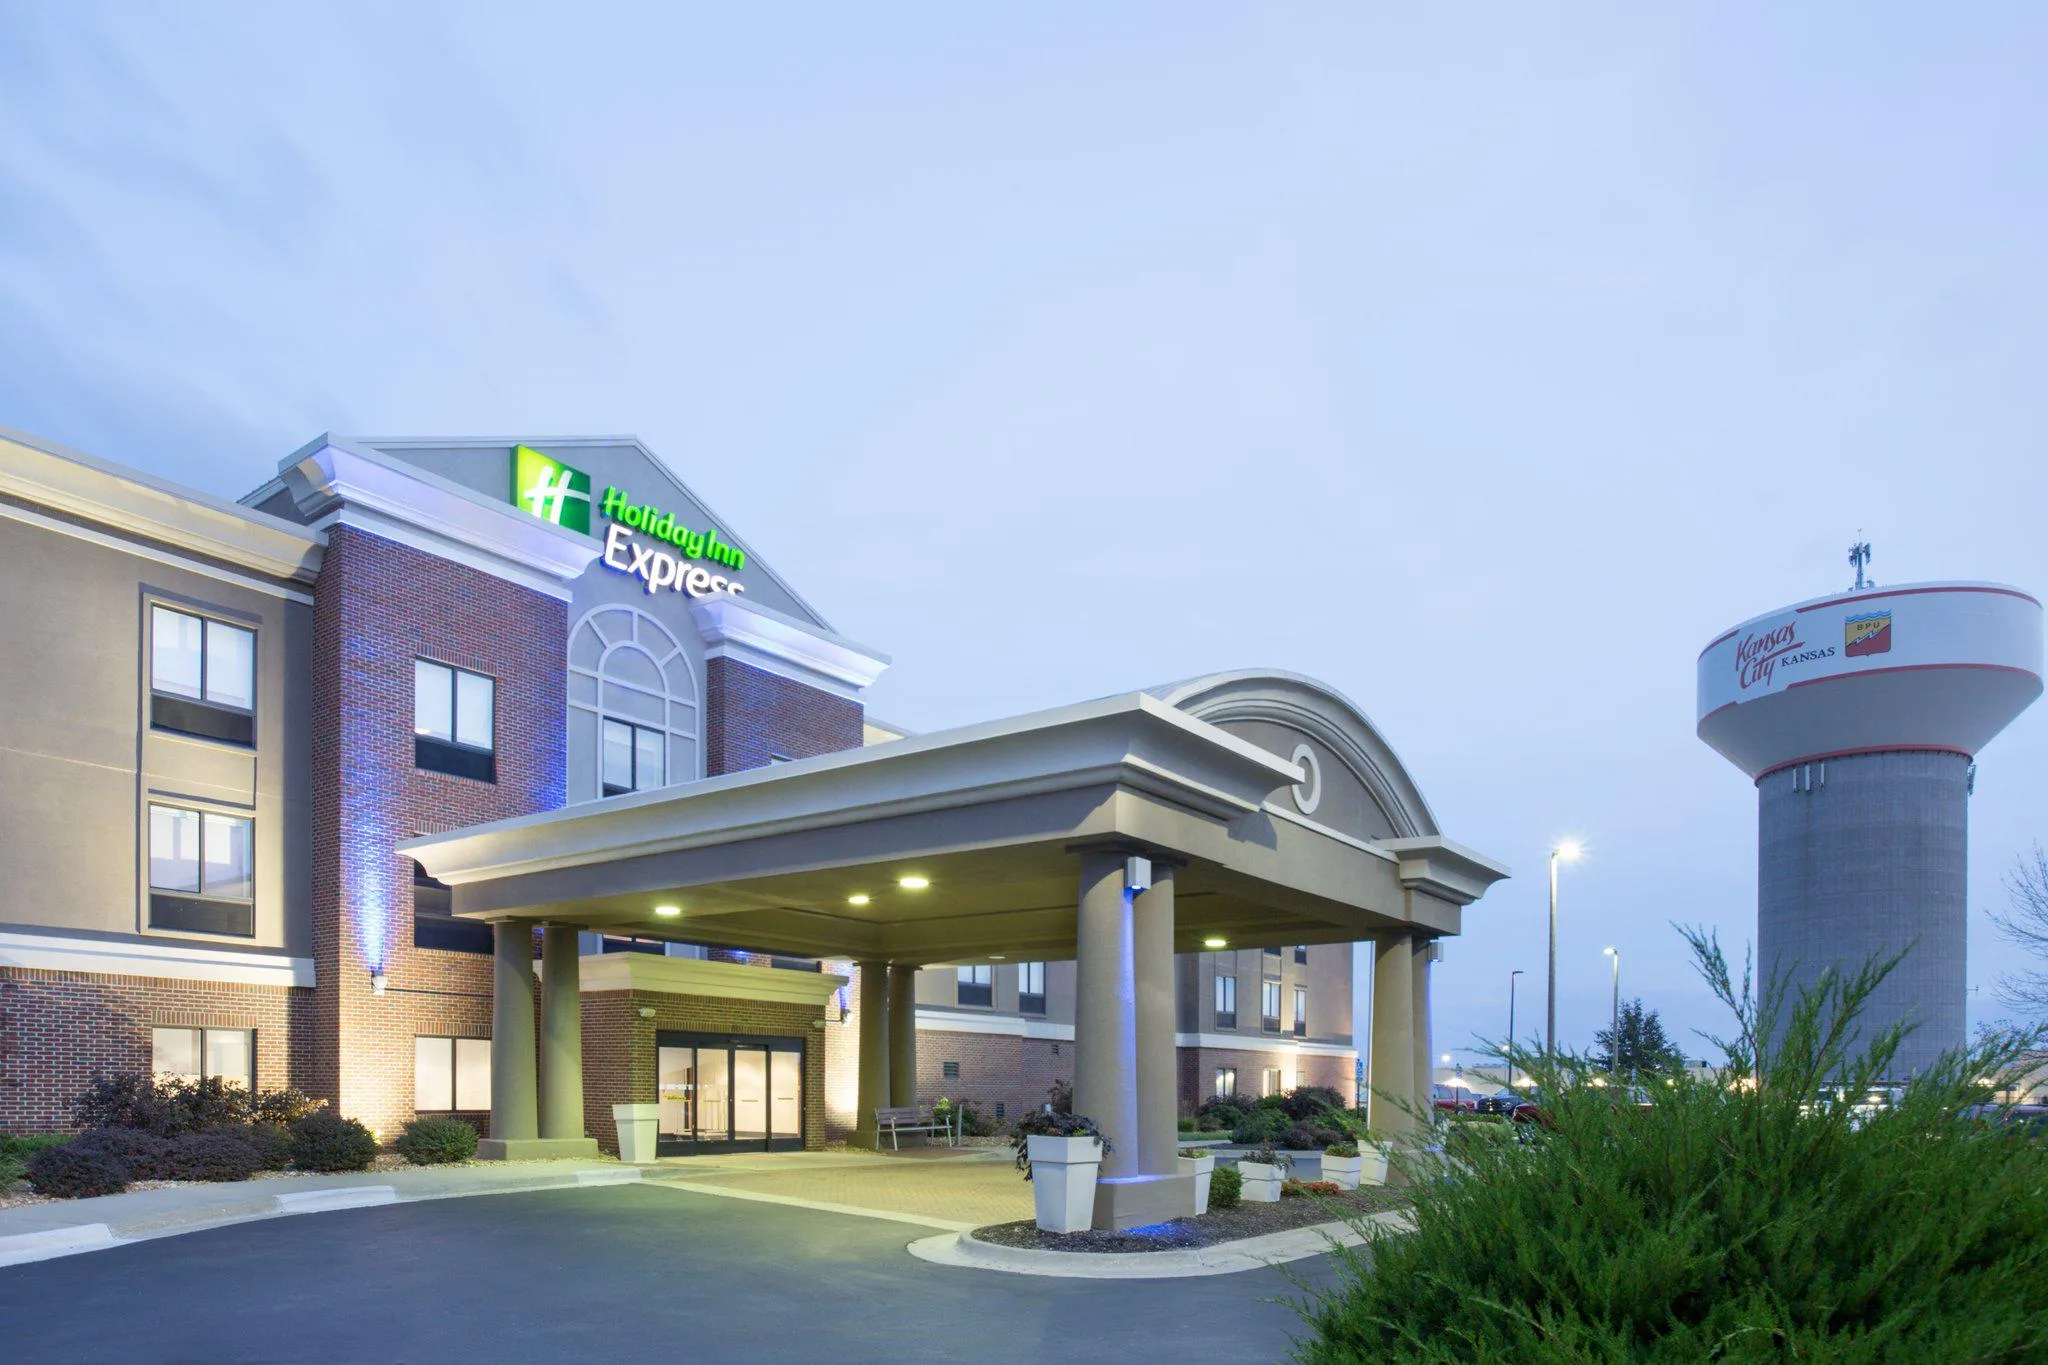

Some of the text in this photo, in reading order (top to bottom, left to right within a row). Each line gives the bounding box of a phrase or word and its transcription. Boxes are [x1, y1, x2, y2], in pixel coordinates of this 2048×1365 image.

[602, 486, 745, 570] Holiday Inn
[1856, 621, 1880, 631] BPU
[1735, 621, 1796, 672] Kansas
[1781, 646, 1835, 667] KANSAS
[1740, 655, 1777, 689] City
